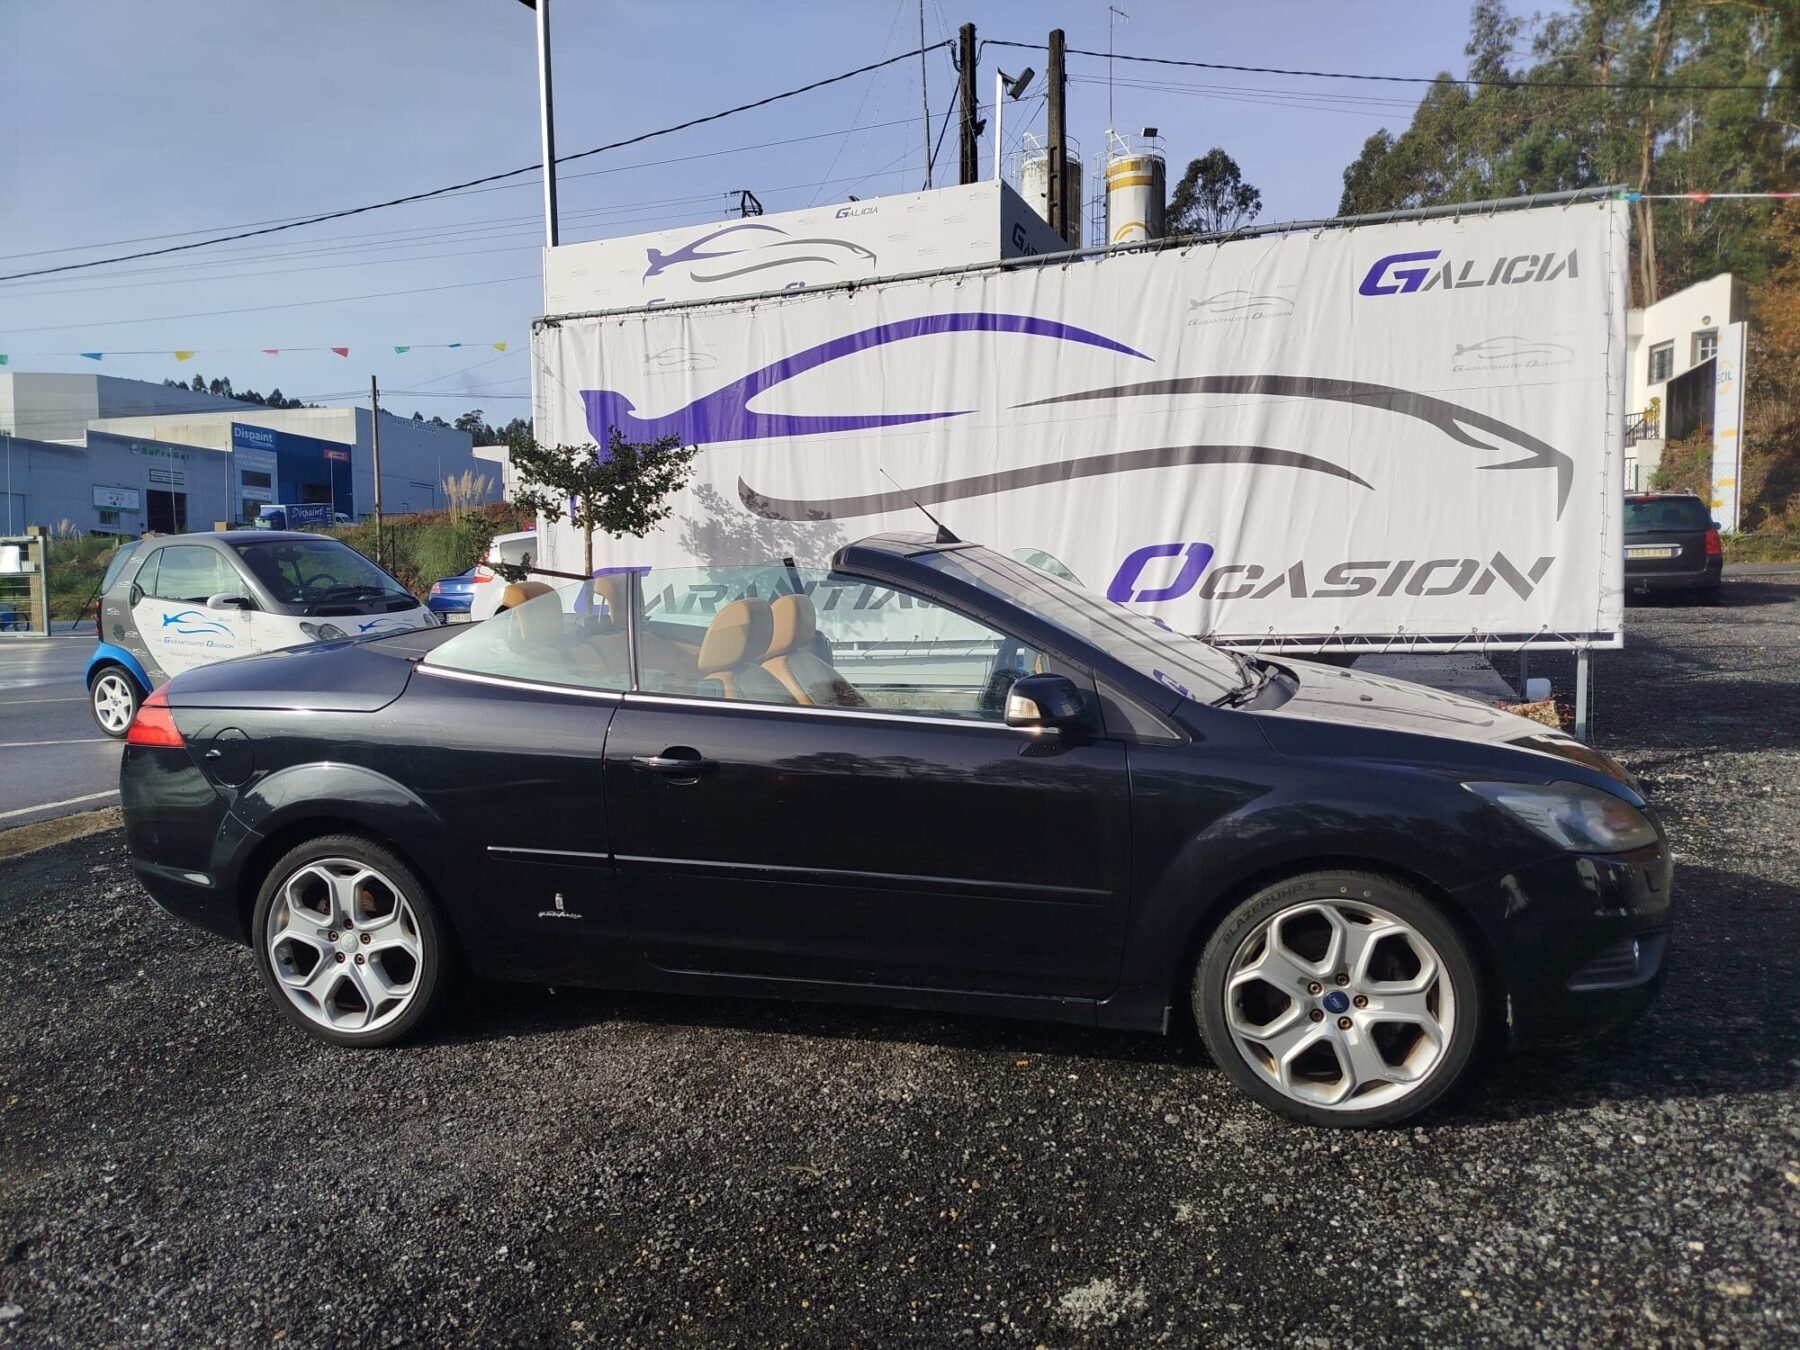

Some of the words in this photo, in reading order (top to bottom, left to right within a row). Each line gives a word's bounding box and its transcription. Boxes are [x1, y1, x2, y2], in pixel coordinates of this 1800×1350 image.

[835, 206, 878, 219] GALICIA
[1358, 247, 1579, 297] GALICIA
[234, 426, 273, 443] Dispaint
[291, 506, 323, 520] Dispaint
[1106, 542, 1556, 602] OCASION
